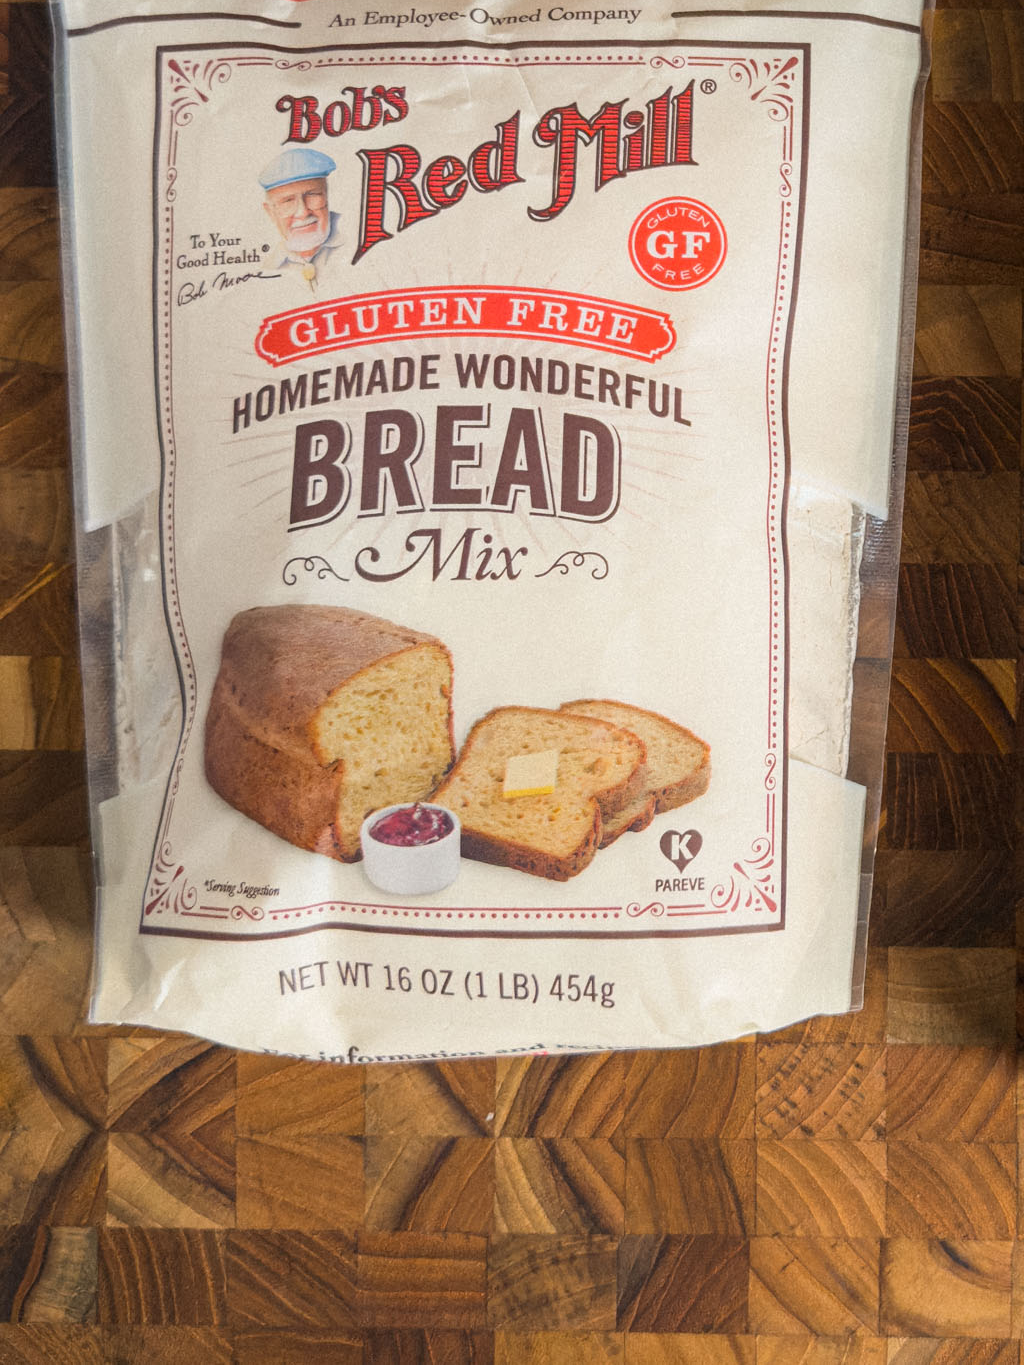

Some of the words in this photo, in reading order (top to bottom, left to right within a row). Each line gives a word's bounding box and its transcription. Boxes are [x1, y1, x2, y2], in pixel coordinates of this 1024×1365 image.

[329, 13, 356, 28] An
[364, 7, 542, 28] Employee-Owned
[547, 6, 643, 24] Company
[275, 84, 410, 146] Bob's
[351, 109, 526, 266] Red
[646, 206, 711, 230] GLUTEN
[189, 233, 206, 250] To
[209, 232, 243, 248] Your
[646, 229, 712, 260] GF
[176, 252, 210, 270] Good
[651, 262, 706, 281] FREE
[288, 298, 488, 349] GLUTEN
[506, 297, 638, 345] FREE
[232, 353, 441, 435] HOMEMADE
[454, 352, 692, 428] WONDERFUL
[287, 402, 623, 534] BREAD
[353, 526, 530, 585] Mix
[236, 881, 281, 899] Suggestion
[655, 877, 706, 893] PAREVE
[279, 960, 329, 995] NET
[337, 960, 374, 988] WT
[383, 964, 413, 993] 16
[421, 968, 456, 996] OZ
[464, 970, 489, 1001] (1
[498, 972, 540, 1004] LB)
[549, 974, 616, 1009] 454g
